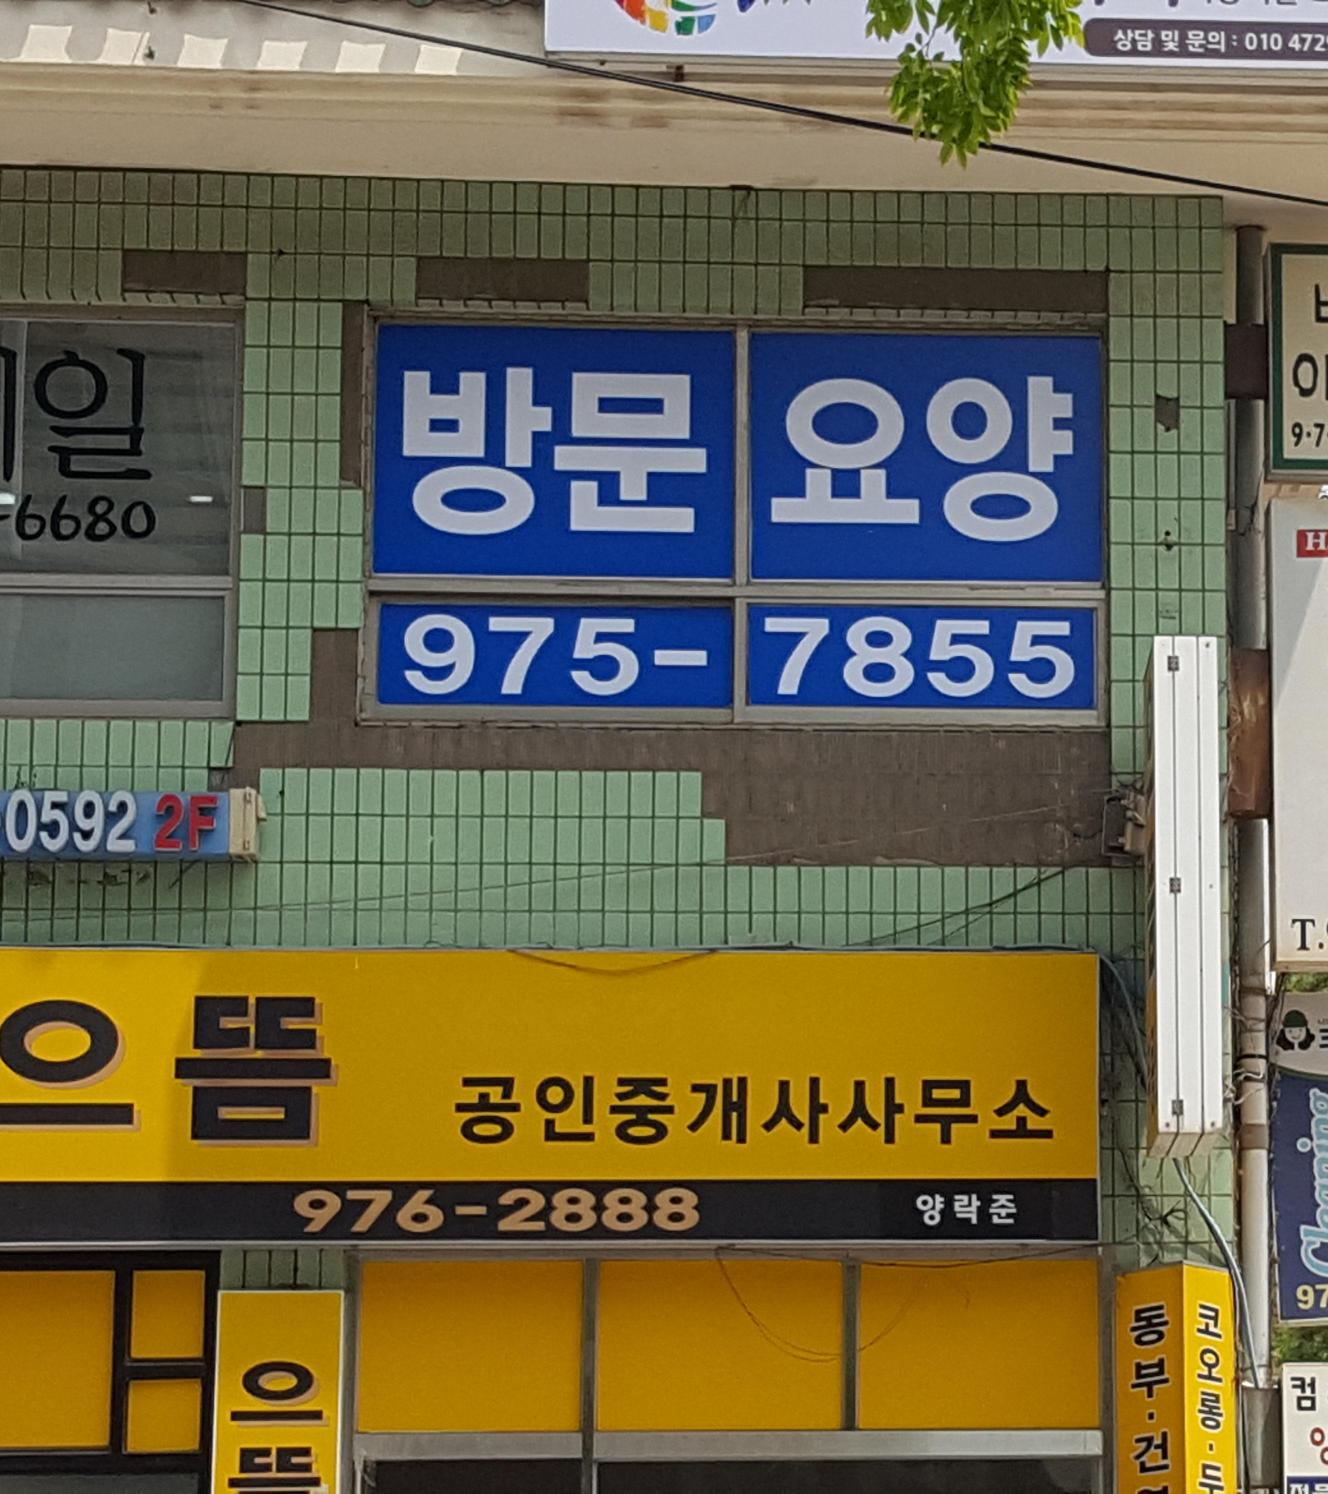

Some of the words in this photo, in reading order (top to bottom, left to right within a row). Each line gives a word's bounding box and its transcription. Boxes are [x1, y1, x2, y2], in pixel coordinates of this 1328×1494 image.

[1113, 28, 1155, 51] 상담
[1160, 29, 1181, 51] 및
[1185, 30, 1226, 52] 문의
[1244, 32, 1283, 52] 010
[0, 347, 152, 480] 일
[5, 788, 137, 854] 0592
[154, 793, 220, 854] 2F
[0, 995, 335, 1144] 으뜸
[454, 1075, 1054, 1145] 공인중개사사무소
[293, 1187, 701, 1233] 976-2888
[915, 1193, 1018, 1226] 양락준
